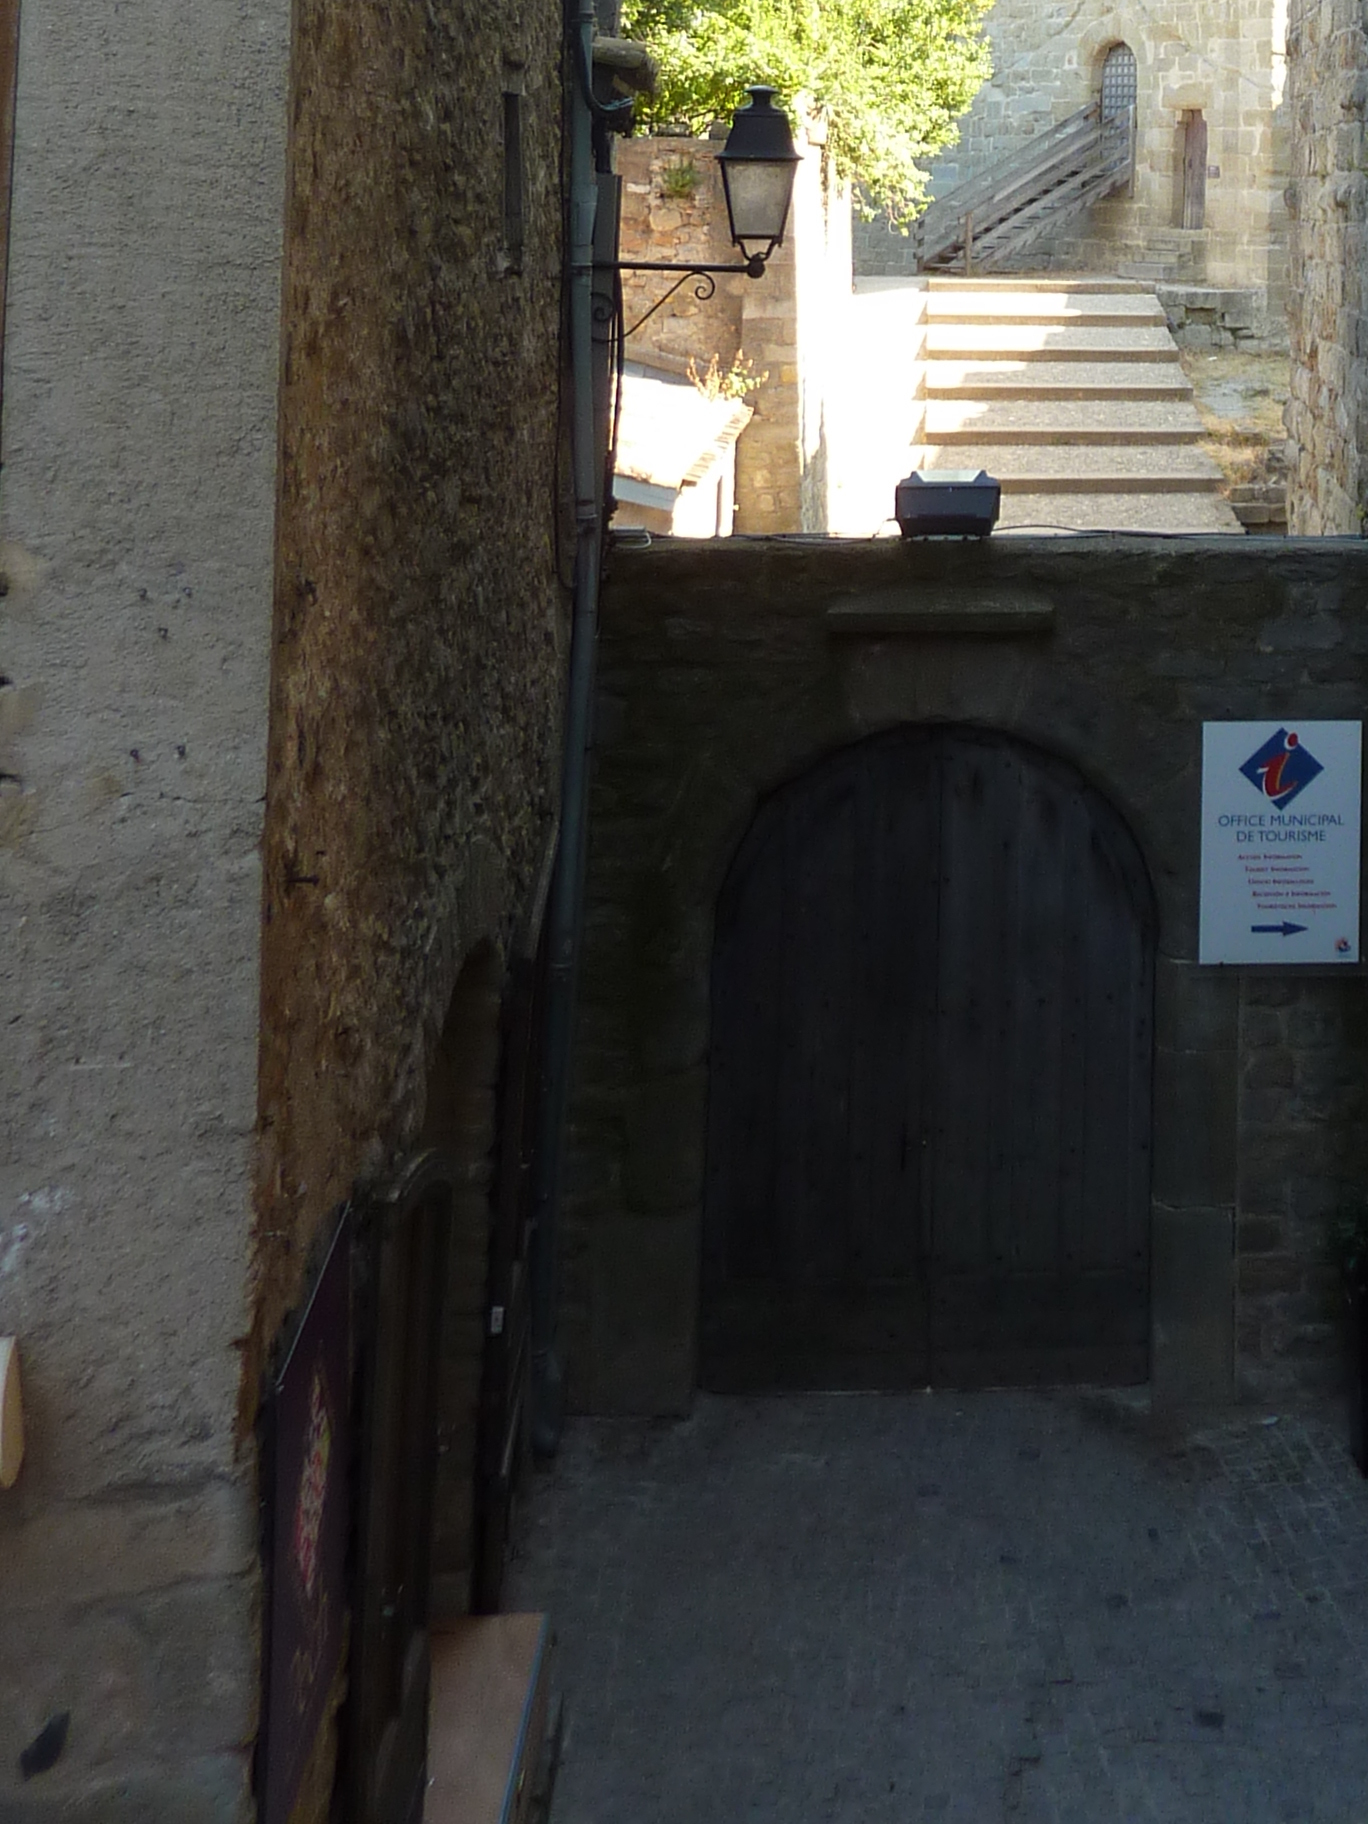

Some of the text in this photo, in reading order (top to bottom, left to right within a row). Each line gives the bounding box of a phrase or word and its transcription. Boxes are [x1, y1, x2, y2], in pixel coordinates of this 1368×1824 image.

[1218, 814, 1344, 827] OFFICE MUNICIPAL
[1236, 829, 1326, 842] DE TOURISME
